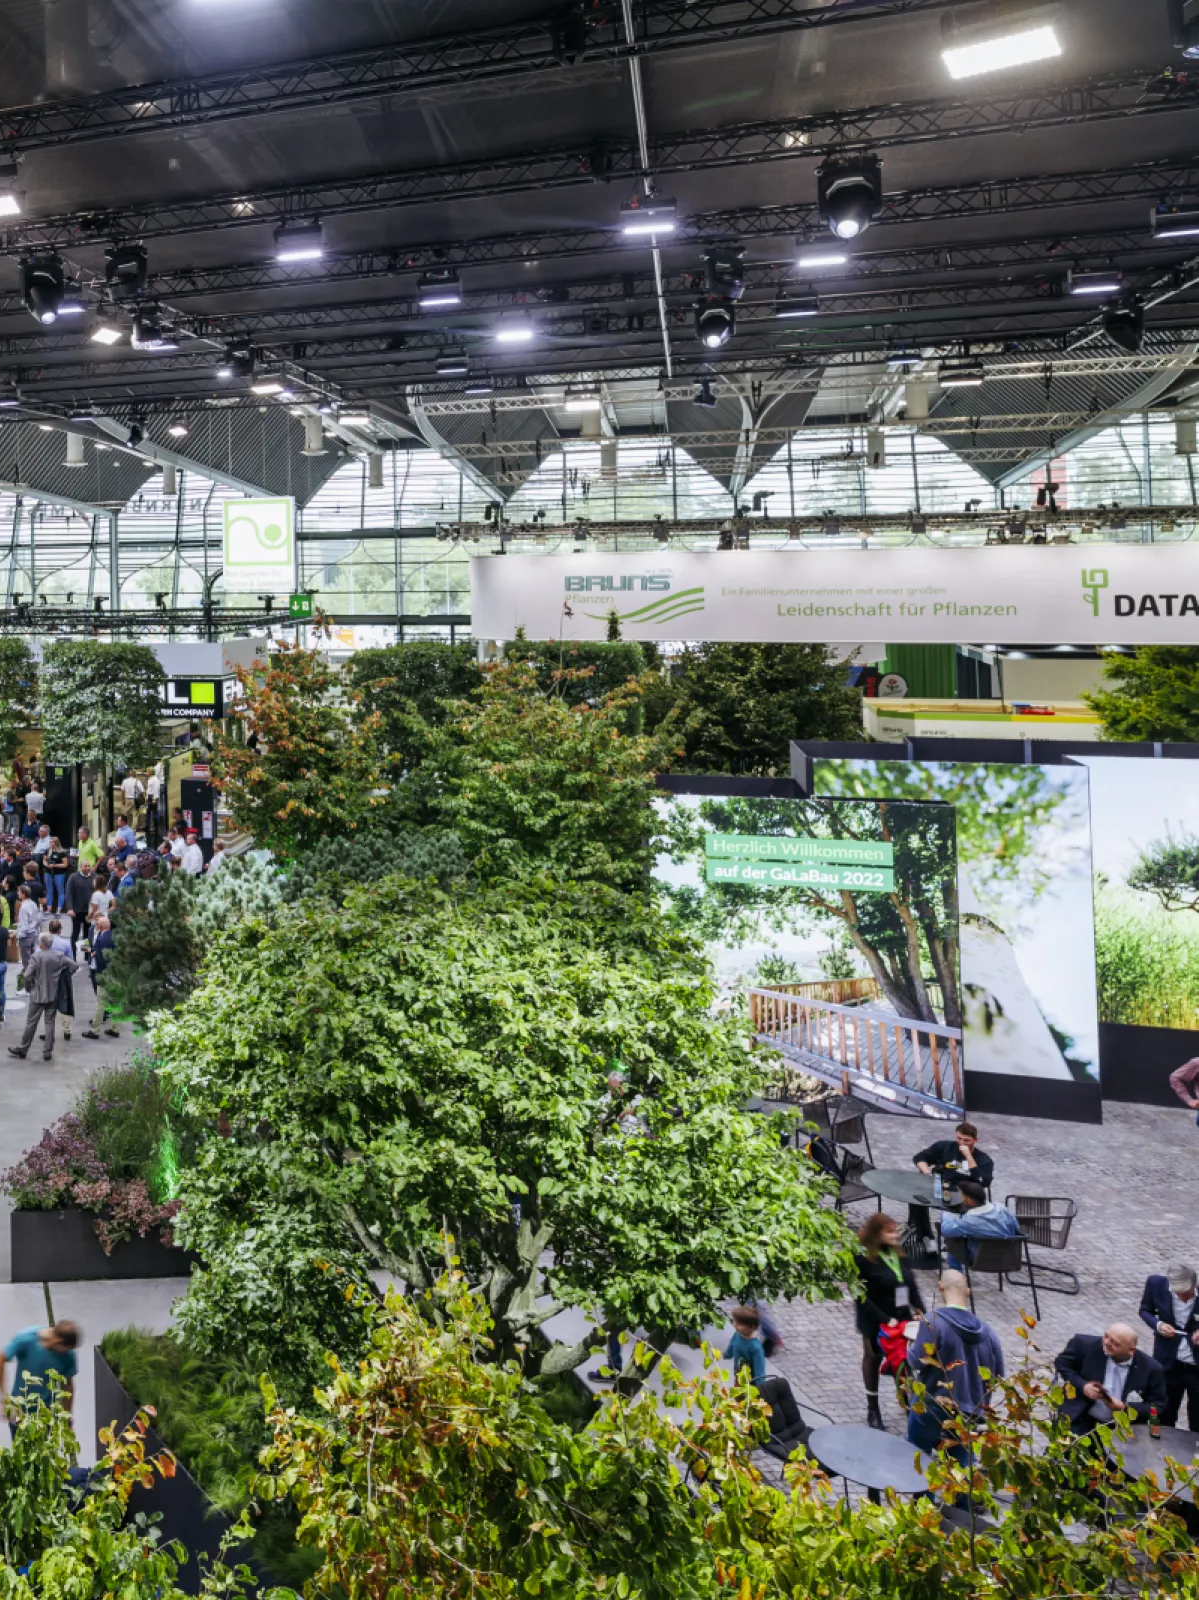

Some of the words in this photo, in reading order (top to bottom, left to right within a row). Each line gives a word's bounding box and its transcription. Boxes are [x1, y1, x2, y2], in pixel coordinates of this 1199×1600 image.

[721, 587, 737, 596] Ein
[739, 587, 853, 597] Familienunternehmen
[856, 586, 873, 595] mit
[876, 586, 904, 595] einer
[777, 602, 892, 617] Leidenschaft
[899, 602, 927, 616] für
[933, 602, 1017, 617] Pflanzen
[173, 708, 215, 716] COMPANY
[713, 839, 776, 855] Herzlich
[780, 842, 885, 861] Willkommen
[714, 865, 738, 878] auf
[741, 866, 767, 879] der
[770, 867, 839, 883] GaLaBau
[843, 871, 885, 887] 2022
